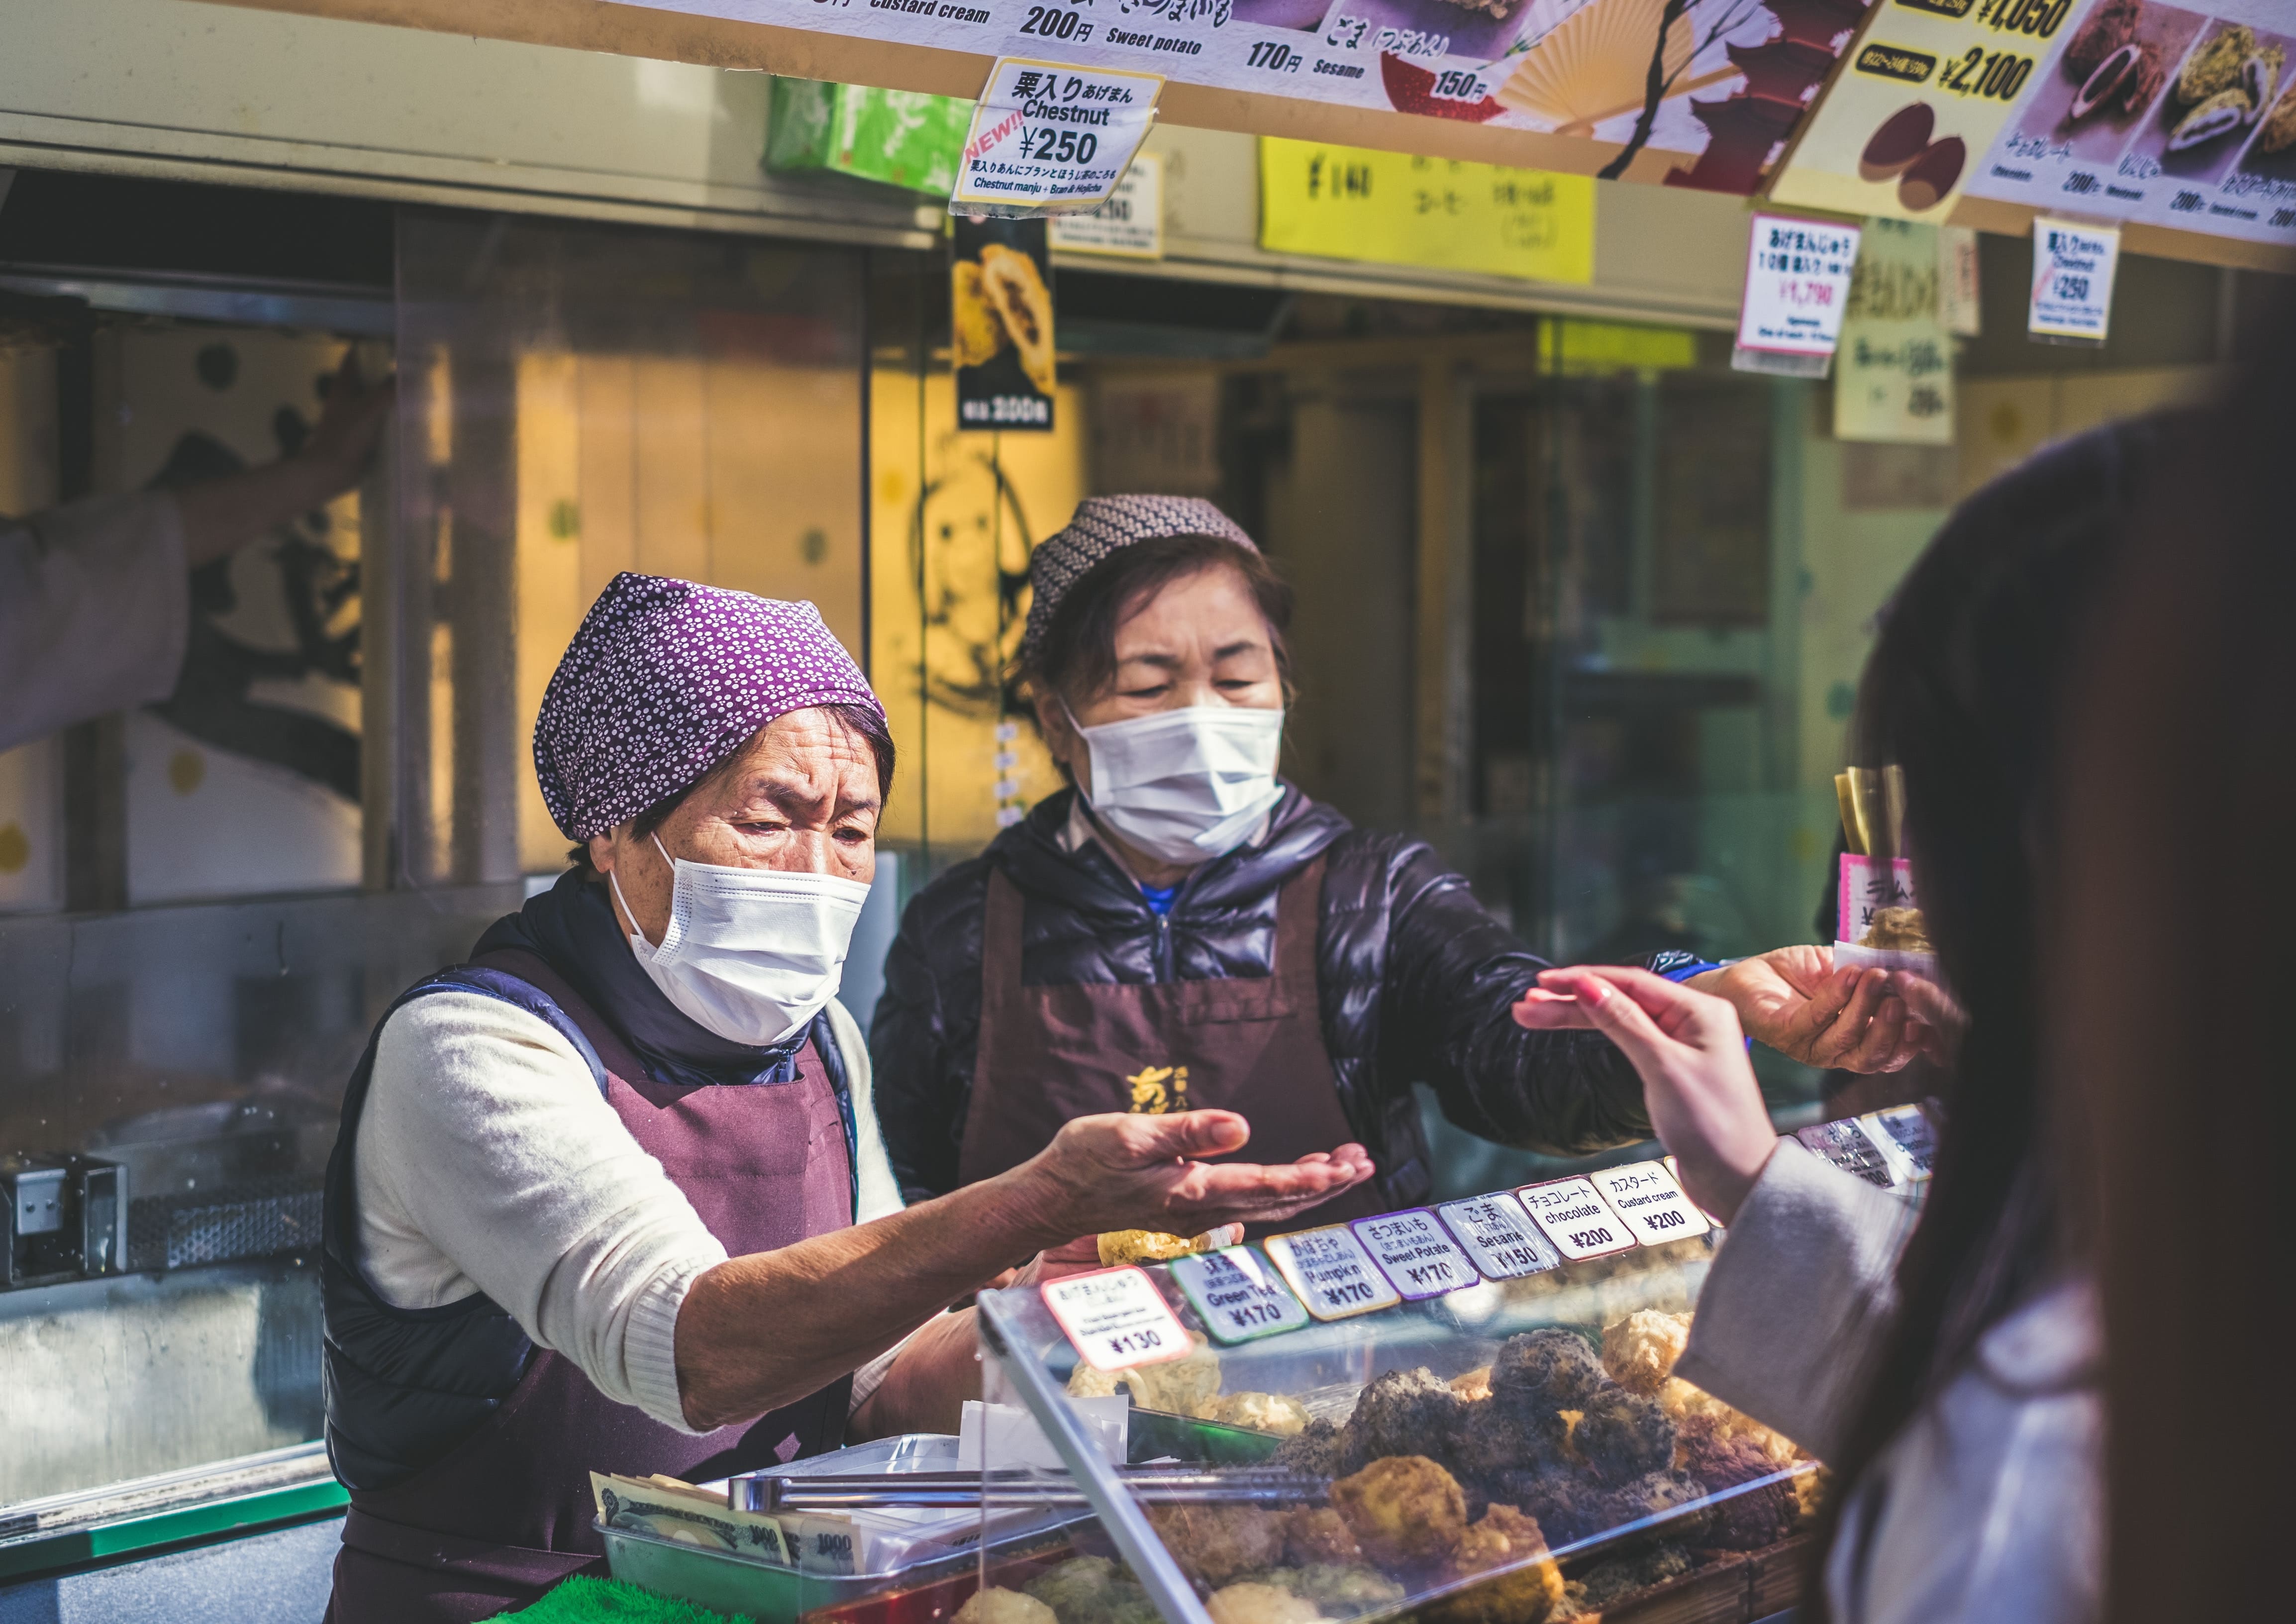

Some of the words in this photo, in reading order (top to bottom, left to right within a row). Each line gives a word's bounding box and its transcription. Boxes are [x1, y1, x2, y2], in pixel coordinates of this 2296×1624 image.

[938, 5, 990, 24] cream
[1020, 6, 1094, 42] 200円
[1106, 27, 1154, 48] Sweet
[1152, 36, 1202, 55] potato
[1326, 18, 1367, 49] ごま
[1247, 41, 1302, 73] 170円
[1940, 47, 2033, 101] ¥2,100
[1022, 100, 1110, 126] Chestnut
[965, 109, 1024, 164] NEW!!
[1019, 125, 1098, 164] ¥250
[974, 177, 1013, 191] Chestnut
[1014, 182, 1041, 195] manju
[1609, 1171, 1659, 1193] カスタード
[1528, 1186, 1590, 1209] チョコレート
[1617, 1195, 1652, 1209] Custard
[1652, 1190, 1679, 1202] cream
[1464, 1202, 1502, 1223] ごま
[1545, 1204, 1600, 1224] chocolate
[1643, 1210, 1686, 1230] ¥200
[1368, 1218, 1428, 1240] さつまいも
[1477, 1231, 1524, 1248] Sesame
[1568, 1227, 1613, 1248] ¥200
[1382, 1249, 1416, 1265] Sweet
[1491, 1246, 1539, 1269] ¥150
[1405, 1262, 1453, 1285] ¥170
[1206, 1289, 1251, 1307] Green
[1323, 1282, 1374, 1306] ¥170
[1228, 1303, 1282, 1327] ¥170
[1108, 1329, 1161, 1354] ¥130
[817, 1533, 852, 1551] 1000
